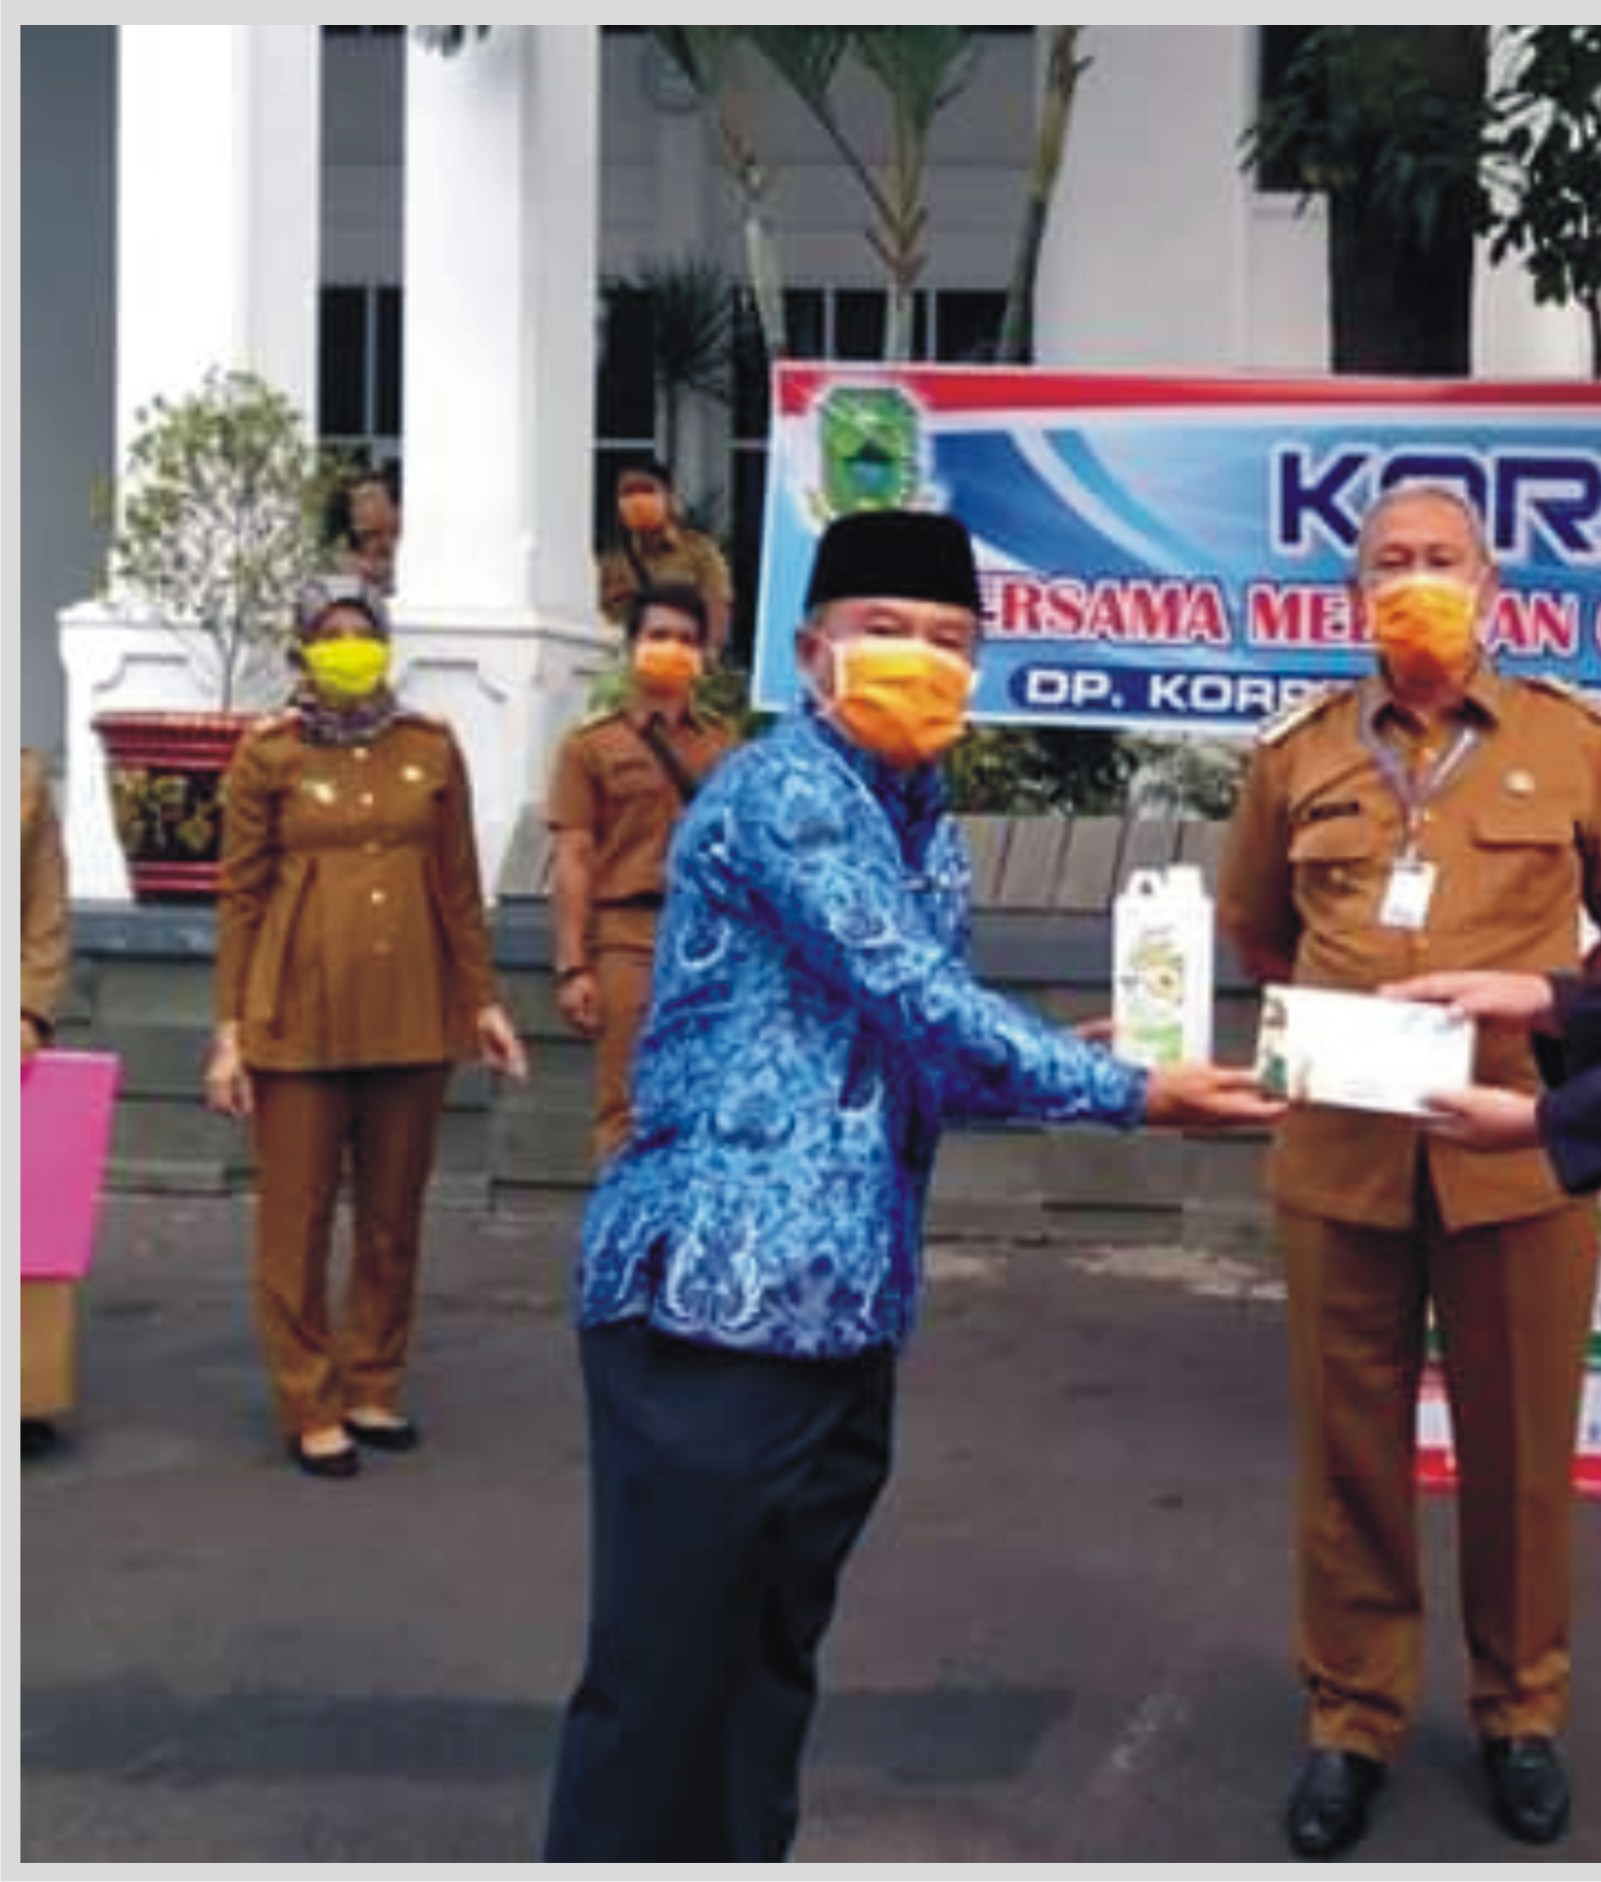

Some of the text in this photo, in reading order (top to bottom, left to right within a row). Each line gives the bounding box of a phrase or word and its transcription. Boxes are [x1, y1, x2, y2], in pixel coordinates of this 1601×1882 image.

[979, 578, 1230, 645] RSAMA
[1248, 584, 1578, 658] MELAN
[1026, 670, 1125, 708] DP.
[1149, 675, 1356, 714] KORP
